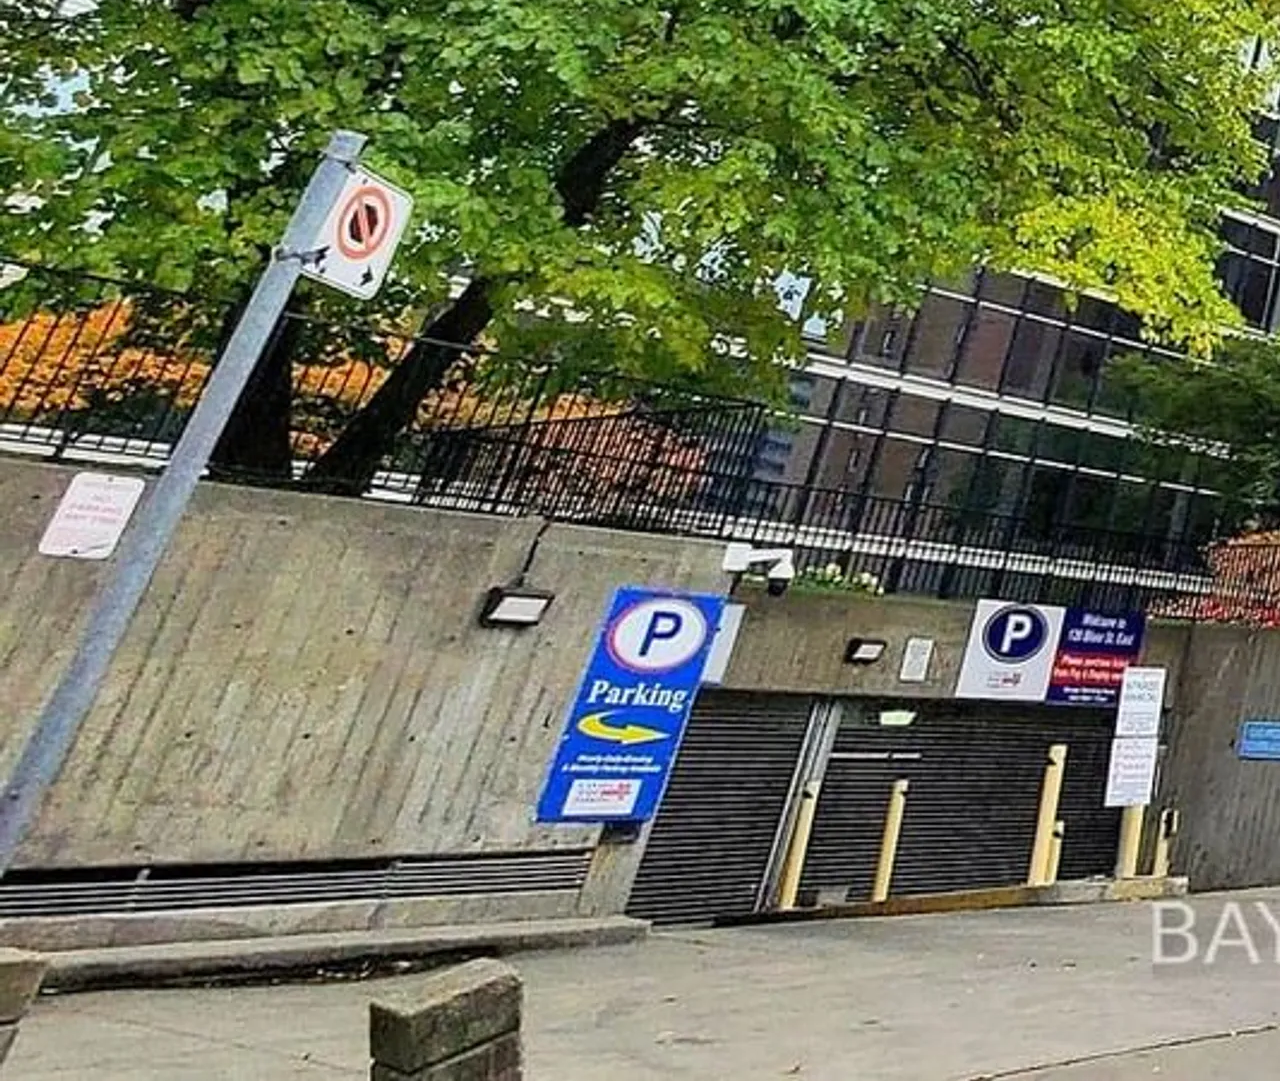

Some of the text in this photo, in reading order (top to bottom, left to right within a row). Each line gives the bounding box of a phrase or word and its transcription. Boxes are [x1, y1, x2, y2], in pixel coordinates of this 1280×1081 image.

[639, 611, 683, 656] P
[1001, 614, 1033, 653] P
[586, 680, 688, 713] Parking
